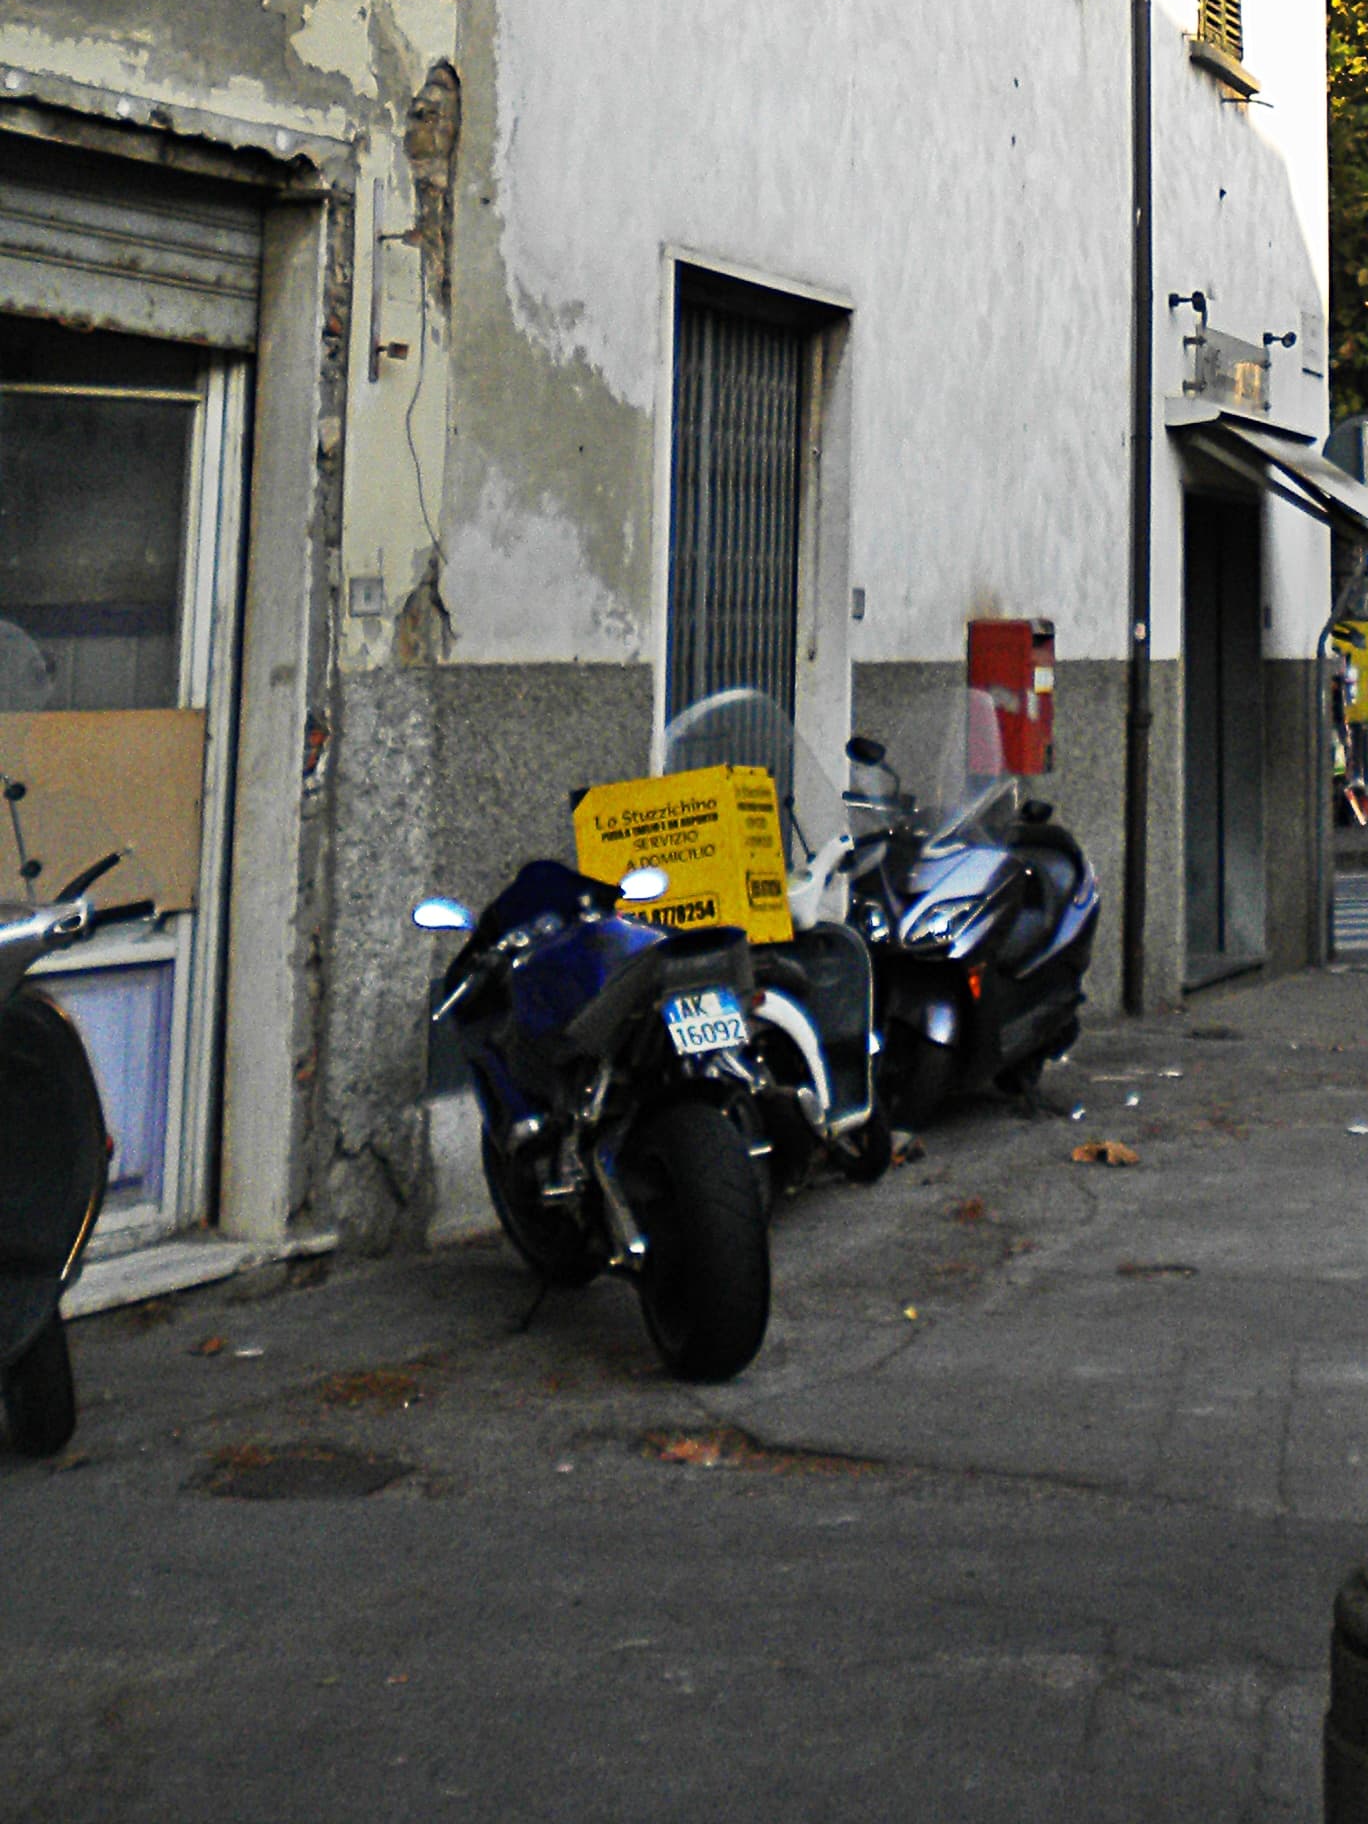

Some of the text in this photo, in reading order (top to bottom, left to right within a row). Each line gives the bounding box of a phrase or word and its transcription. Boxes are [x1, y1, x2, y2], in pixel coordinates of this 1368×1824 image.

[595, 814, 617, 831] Lo
[621, 798, 718, 826] Stuzzichino
[633, 829, 699, 851] SERVIZIO
[626, 844, 716, 873] A DOMICILIO
[681, 995, 708, 1019] AK
[676, 1018, 745, 1048] 16092
